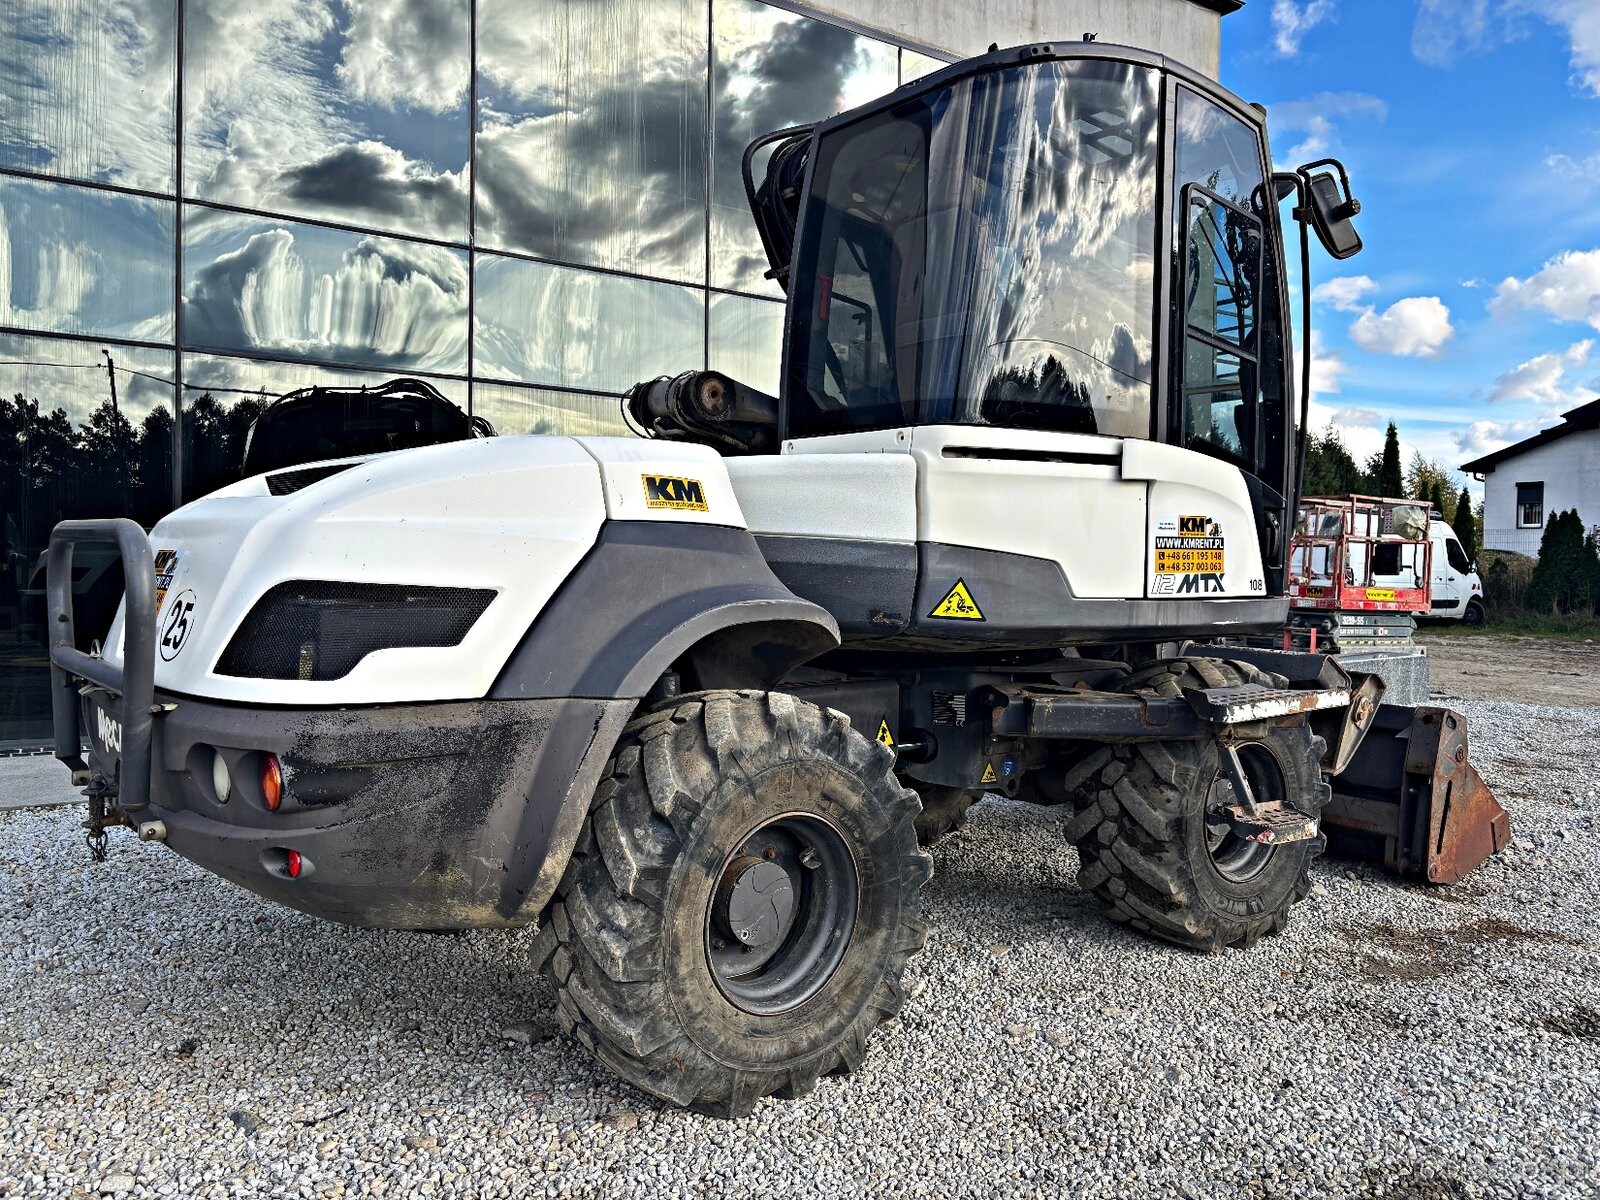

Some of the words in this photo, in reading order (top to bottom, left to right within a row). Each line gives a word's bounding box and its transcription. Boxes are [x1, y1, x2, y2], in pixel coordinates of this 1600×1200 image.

[646, 477, 704, 503] KM
[1179, 517, 1205, 532] KM
[1156, 537, 1224, 549] WWW.KMRENT.PL
[1166, 552, 1180, 560] +48
[1181, 552, 1195, 560] 661
[1196, 552, 1209, 560] 195
[1210, 552, 1222, 560] 148
[1166, 563, 1180, 571] +48
[1181, 563, 1195, 571] 537
[1197, 563, 1208, 571] 003
[1209, 563, 1222, 571] 063
[1151, 574, 1176, 594] 12
[1176, 573, 1226, 593] MTX
[1249, 579, 1263, 591] 108
[1307, 587, 1323, 595] KM
[162, 599, 195, 651] 25
